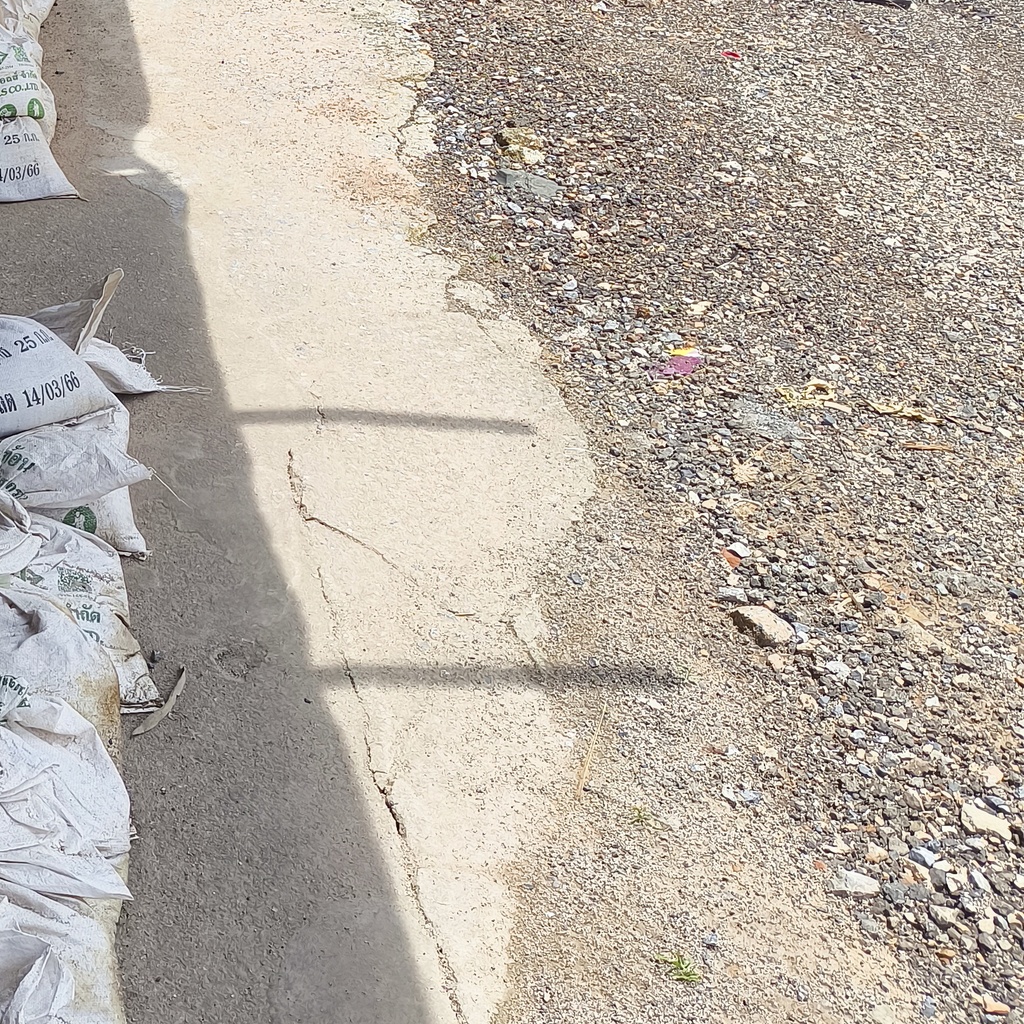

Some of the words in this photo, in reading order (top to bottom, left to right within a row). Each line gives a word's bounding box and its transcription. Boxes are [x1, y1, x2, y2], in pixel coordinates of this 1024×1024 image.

[4, 134, 20, 145] 25
[24, 132, 40, 143] ก.ก.
[14, 335, 37, 353] 25
[22, 371, 81, 409] 14/03/66
[65, 602, 101, 625] ำกัด
